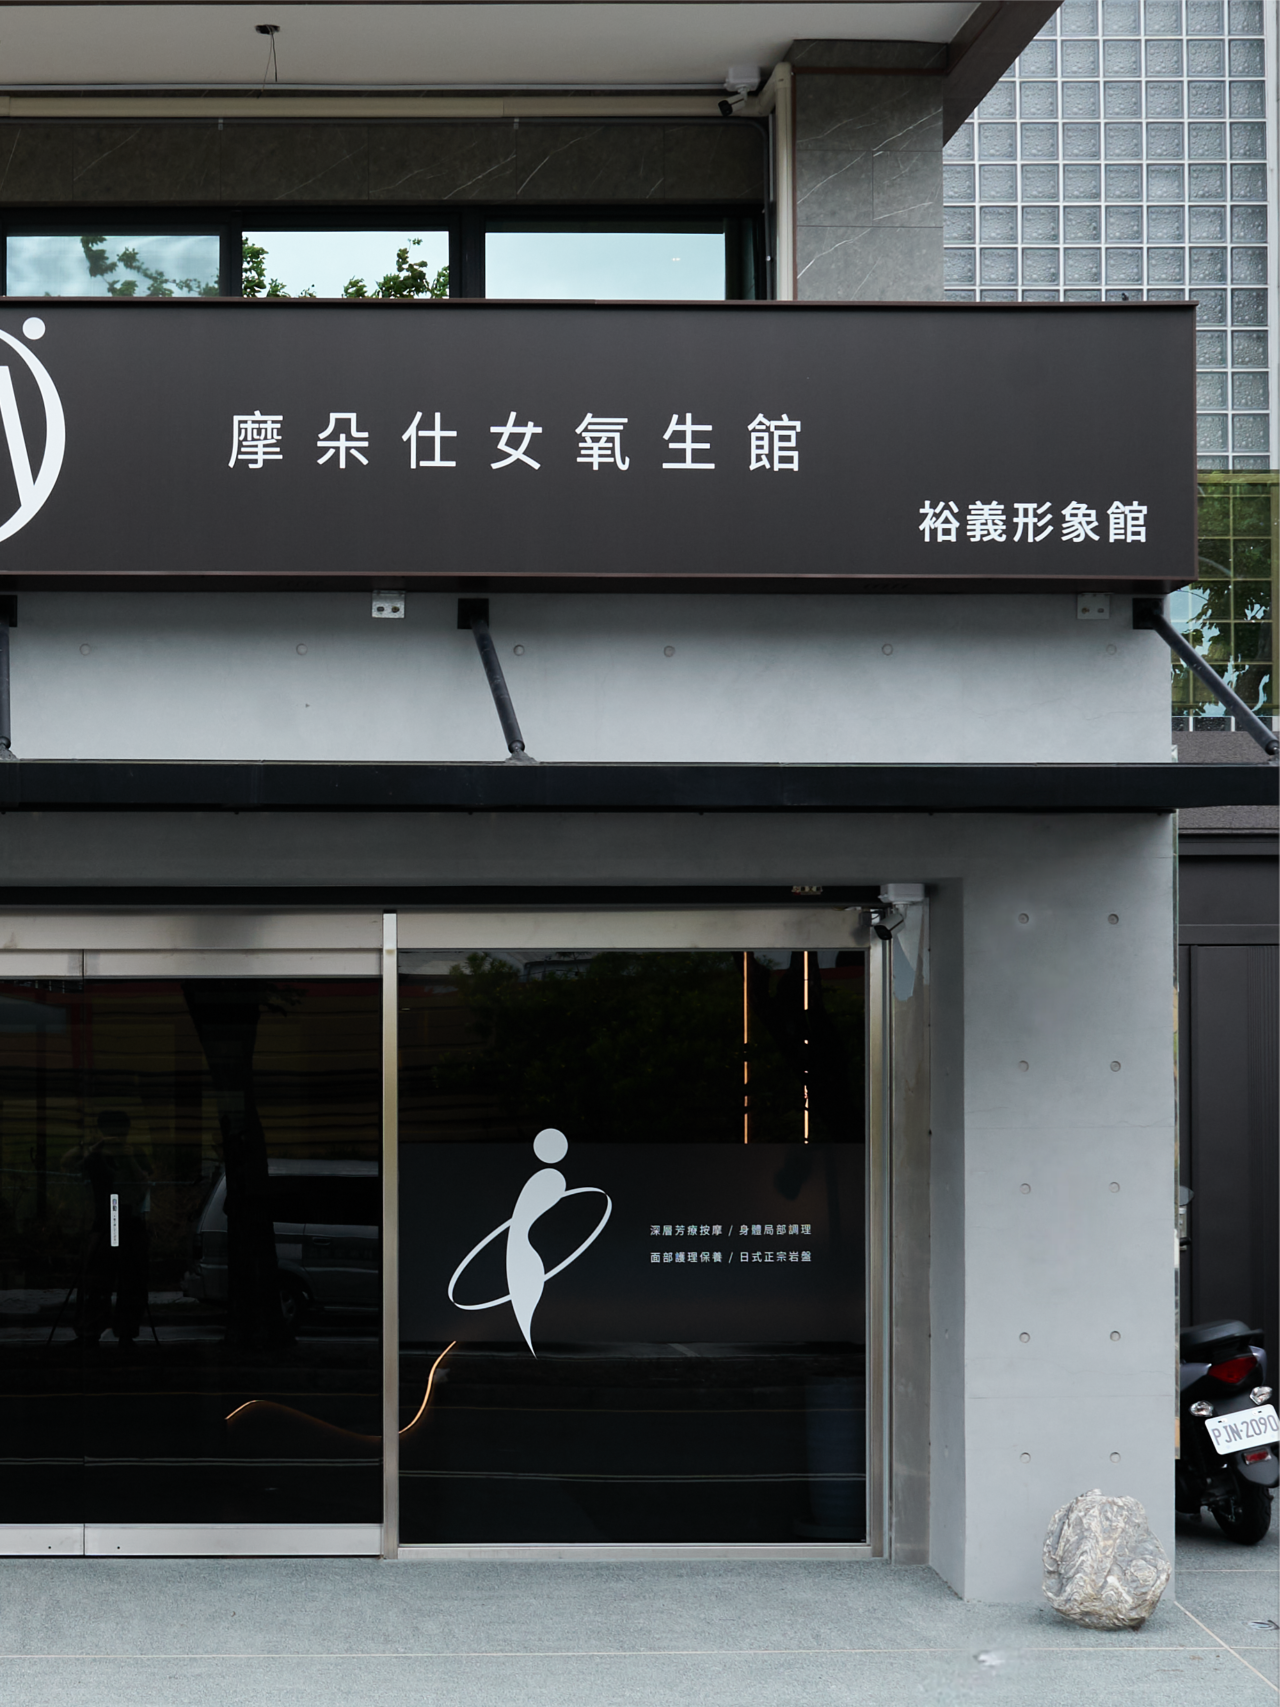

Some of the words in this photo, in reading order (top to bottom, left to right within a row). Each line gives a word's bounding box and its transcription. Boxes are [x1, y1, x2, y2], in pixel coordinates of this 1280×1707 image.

[227, 410, 803, 473] 摩朵仕女氧生館
[918, 500, 1148, 543] 裕義形象館
[650, 1224, 723, 1236] 深層芳療按摩
[739, 1223, 812, 1236] 身體局部調理
[650, 1251, 723, 1263] 面部護理保養
[740, 1250, 812, 1263] 日式正宗岩盤
